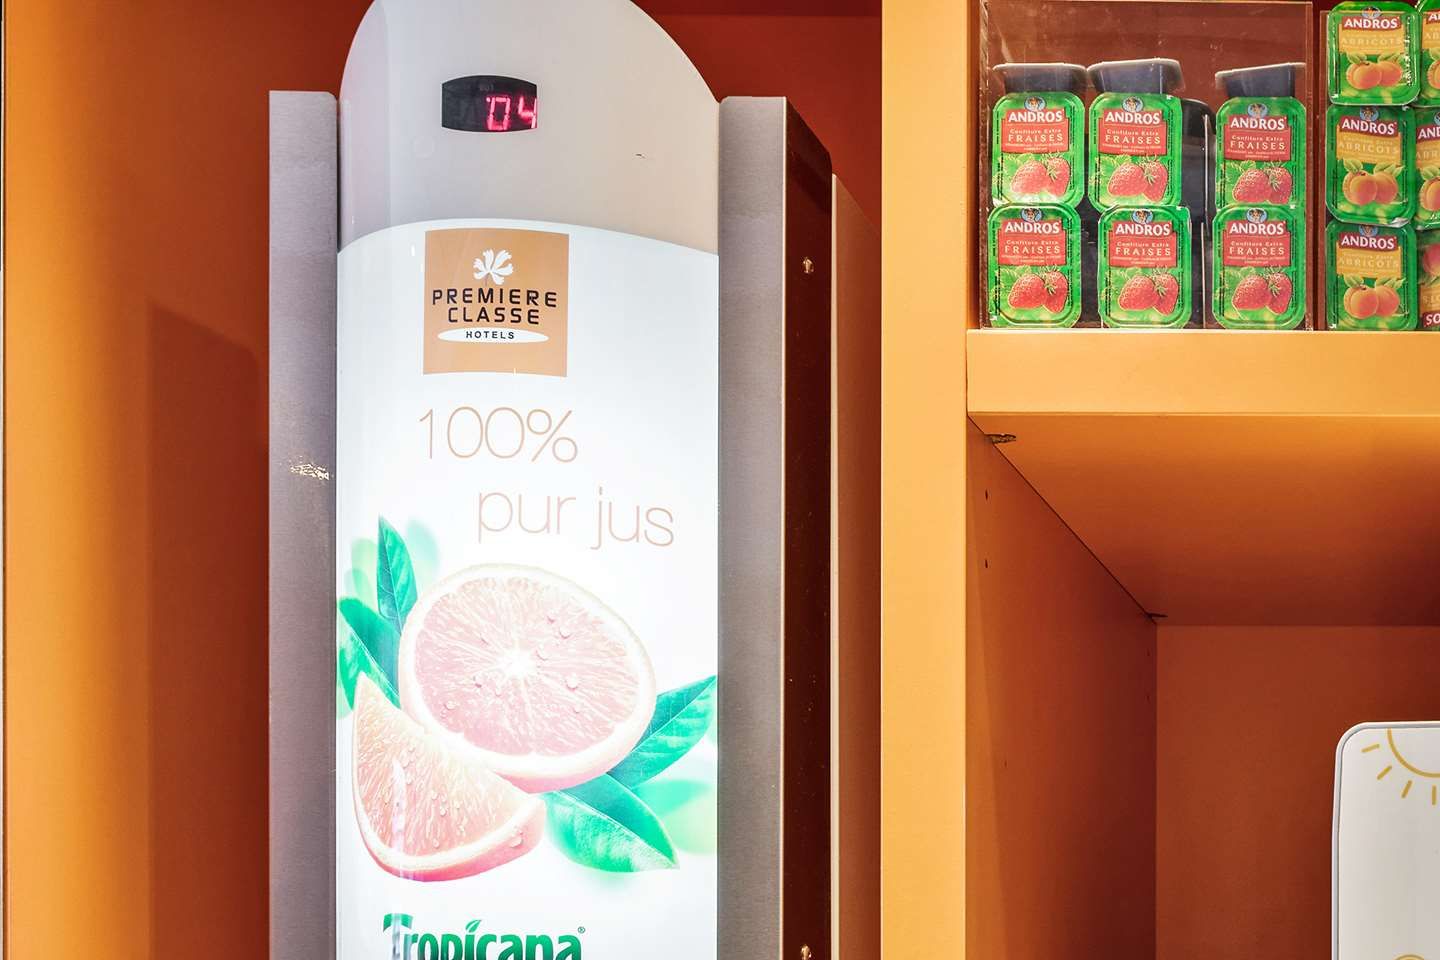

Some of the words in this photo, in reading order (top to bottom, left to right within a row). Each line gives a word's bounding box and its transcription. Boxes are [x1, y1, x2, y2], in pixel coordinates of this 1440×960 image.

[1344, 18, 1398, 29] ANDROS
[1008, 112, 1063, 123] ANDROS
[1105, 112, 1160, 124] ANDROS
[1230, 117, 1285, 130] ANDROS
[1342, 118, 1396, 135] ANDROS
[1008, 134, 1063, 142] FRAISES
[1106, 134, 1160, 144] FRAISES
[1230, 141, 1286, 150] FRAISES
[1004, 222, 1060, 234] ANDROS
[1115, 223, 1170, 236] ANDROS
[1230, 222, 1284, 236] ANDROS
[1340, 236, 1395, 250] ANDROS
[1004, 246, 1060, 254] FRAISES
[1115, 247, 1171, 256] FRAISES
[1229, 247, 1285, 256] FRAISES
[432, 288, 558, 308] PREMIERE
[448, 306, 540, 325] CLASSE
[466, 330, 515, 340] HOTELS
[419, 406, 579, 464] 100%
[478, 490, 576, 544] pur
[590, 486, 674, 550] jus
